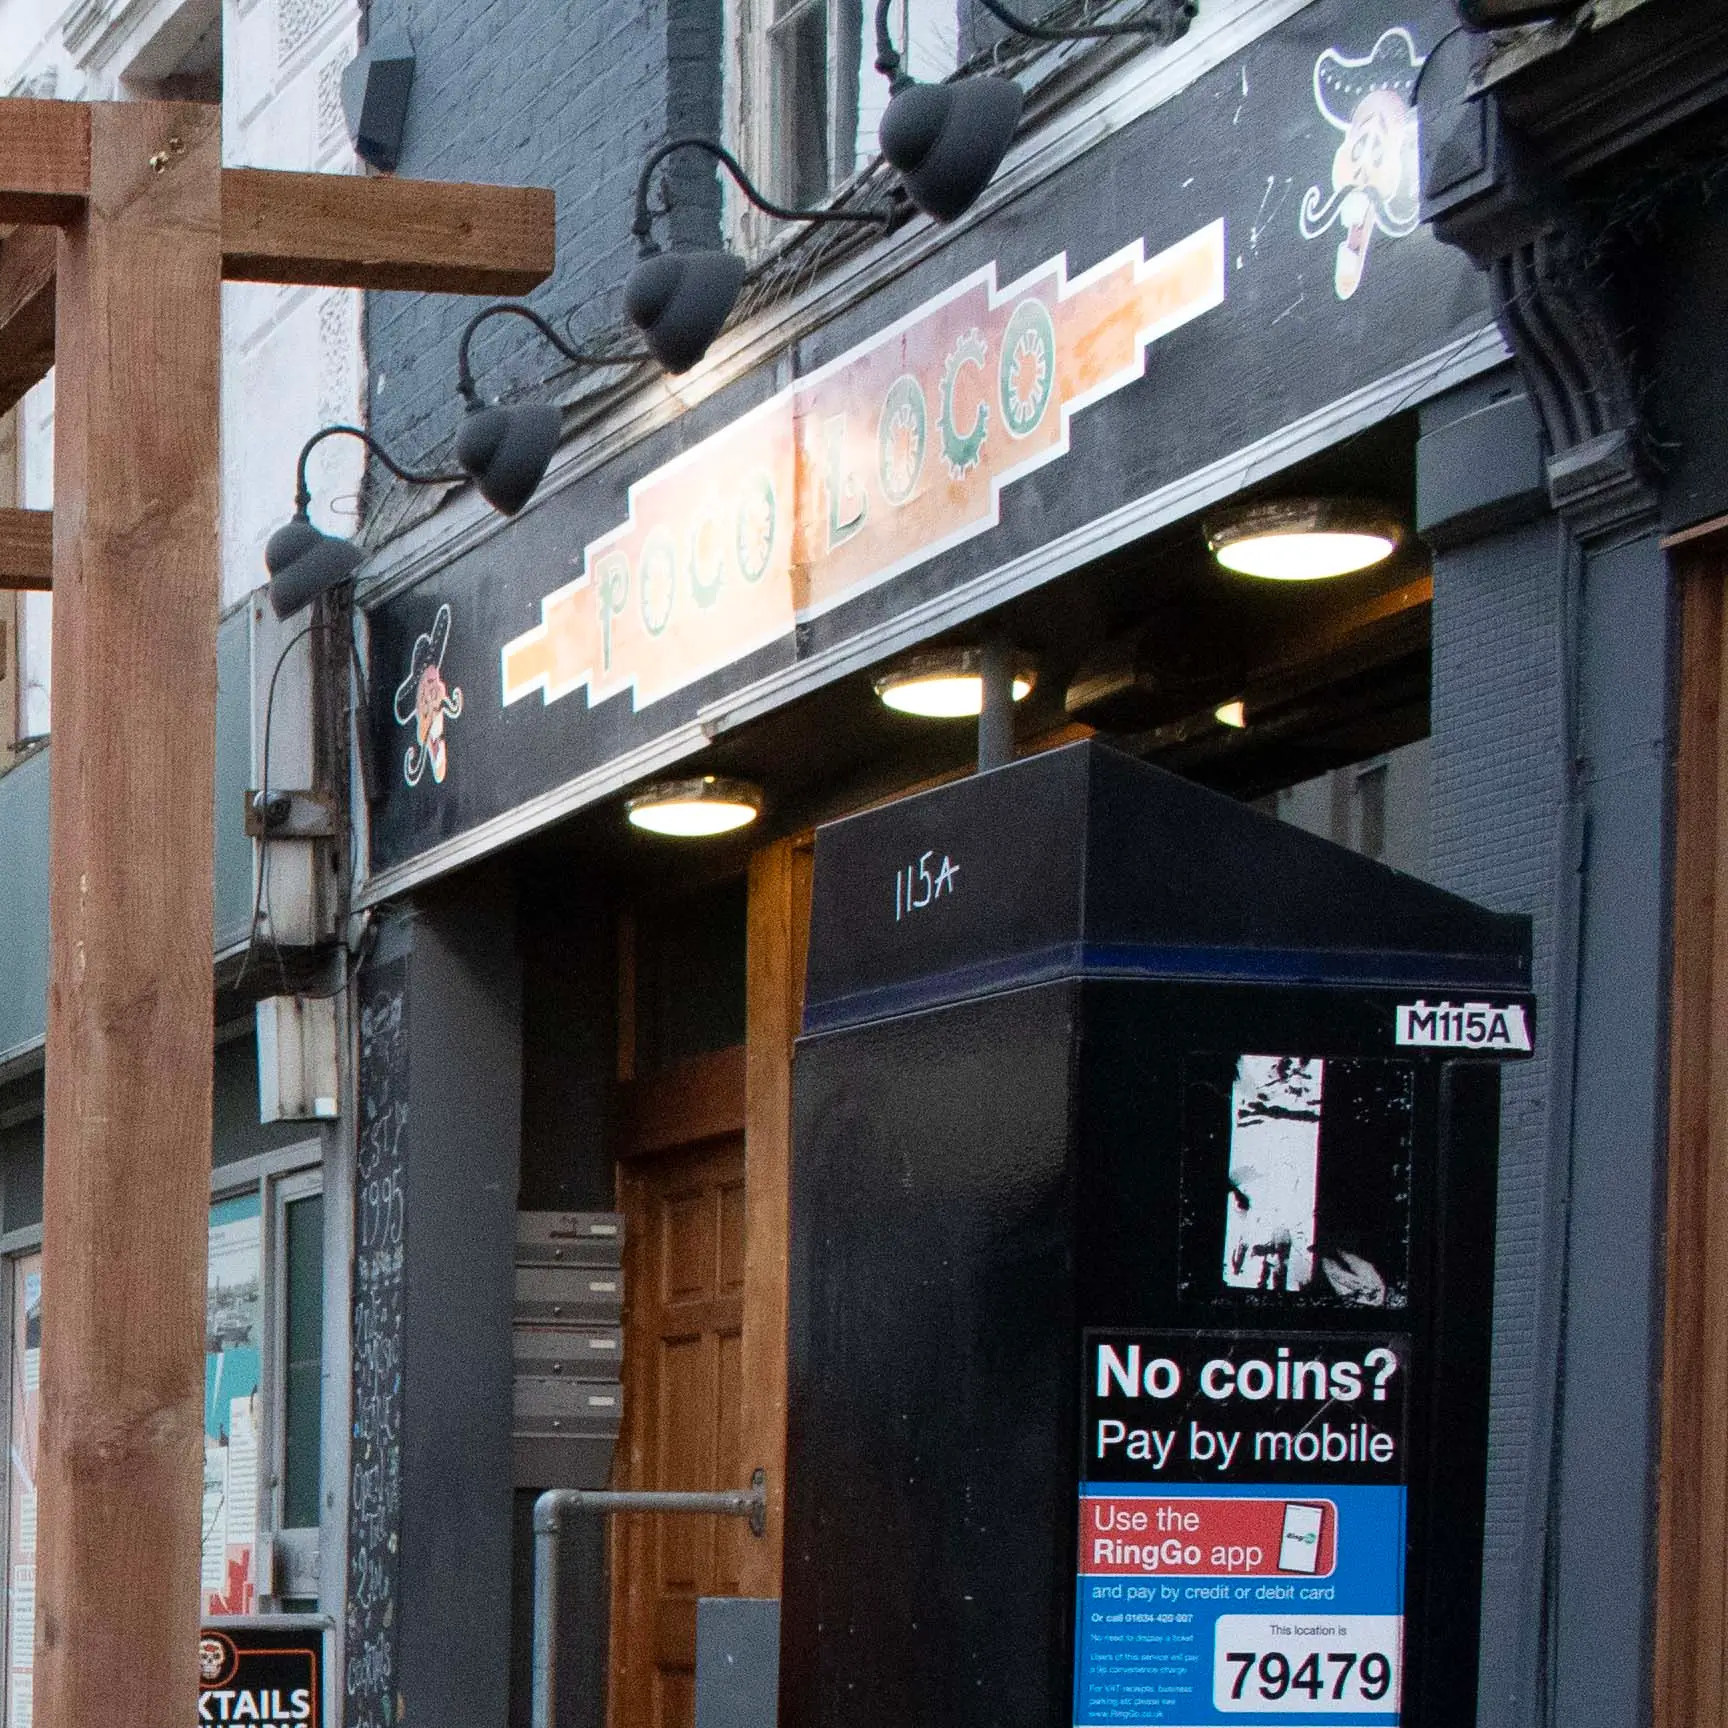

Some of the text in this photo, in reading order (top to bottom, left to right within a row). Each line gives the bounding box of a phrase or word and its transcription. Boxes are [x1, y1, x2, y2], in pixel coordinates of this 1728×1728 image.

[595, 297, 1055, 673] POCO LOCO
[896, 850, 960, 921] 115A
[1408, 1009, 1511, 1044] M115A
[1097, 1343, 1397, 1401] No coins?
[1097, 1420, 1394, 1470] Pay by mobile
[1095, 1505, 1200, 1531] Use the
[1094, 1539, 1263, 1571] RingGo app
[1092, 1585, 1335, 1602] and pay by credit or debit card
[1270, 1624, 1347, 1636] This location is
[1226, 1651, 1391, 1701] 79479
